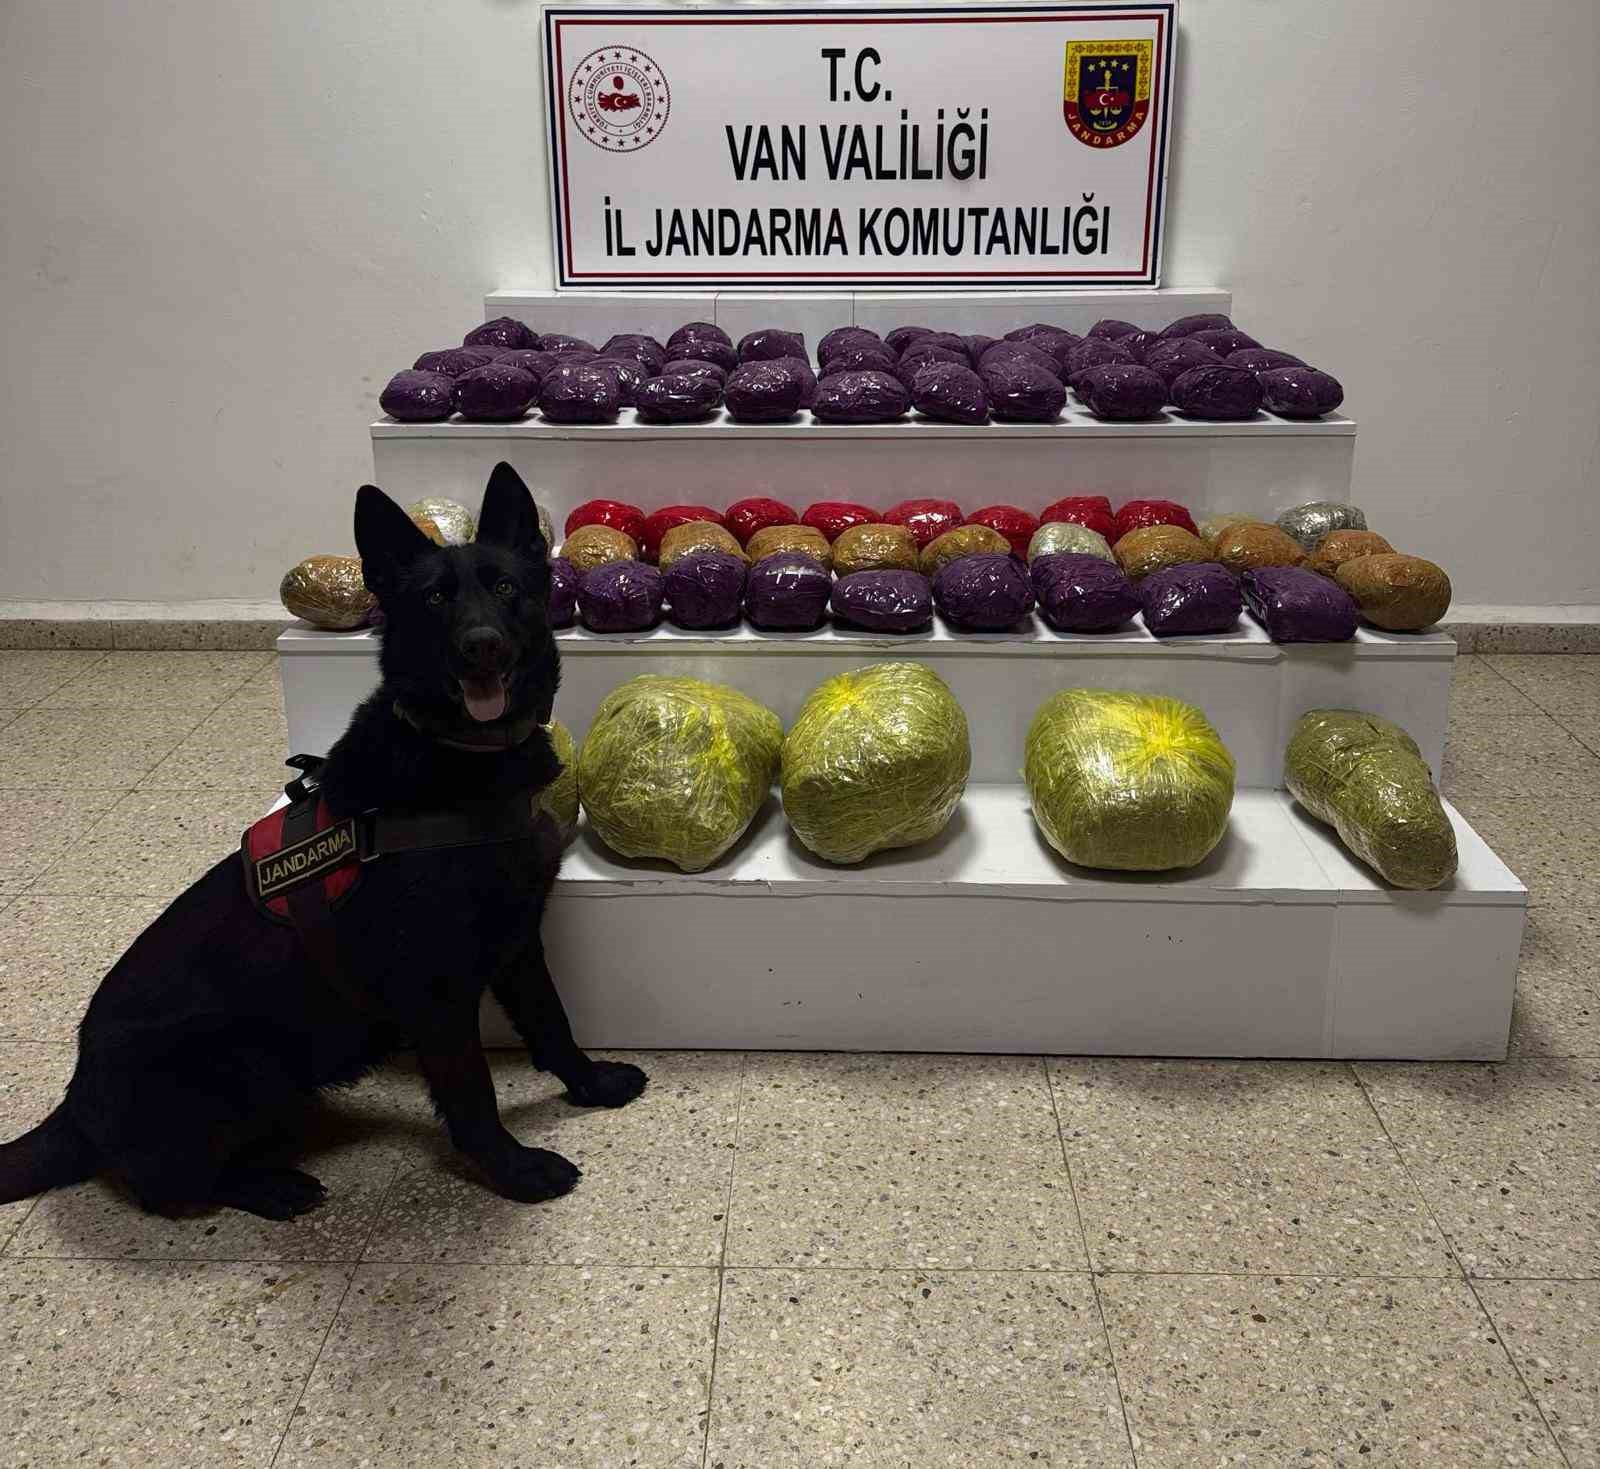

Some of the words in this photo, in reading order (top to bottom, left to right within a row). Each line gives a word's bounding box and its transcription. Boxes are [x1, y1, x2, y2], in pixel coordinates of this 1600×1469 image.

[822, 48, 892, 102] T.C.
[726, 125, 806, 181] VAN
[820, 108, 988, 181] VALİLİĞİ
[1067, 111, 1145, 145] JANDARMA
[605, 196, 635, 256] İL
[646, 207, 848, 256] JANDARMA
[860, 193, 1110, 256] KOMUTANLIĞI
[262, 829, 352, 885] JANDARMA
